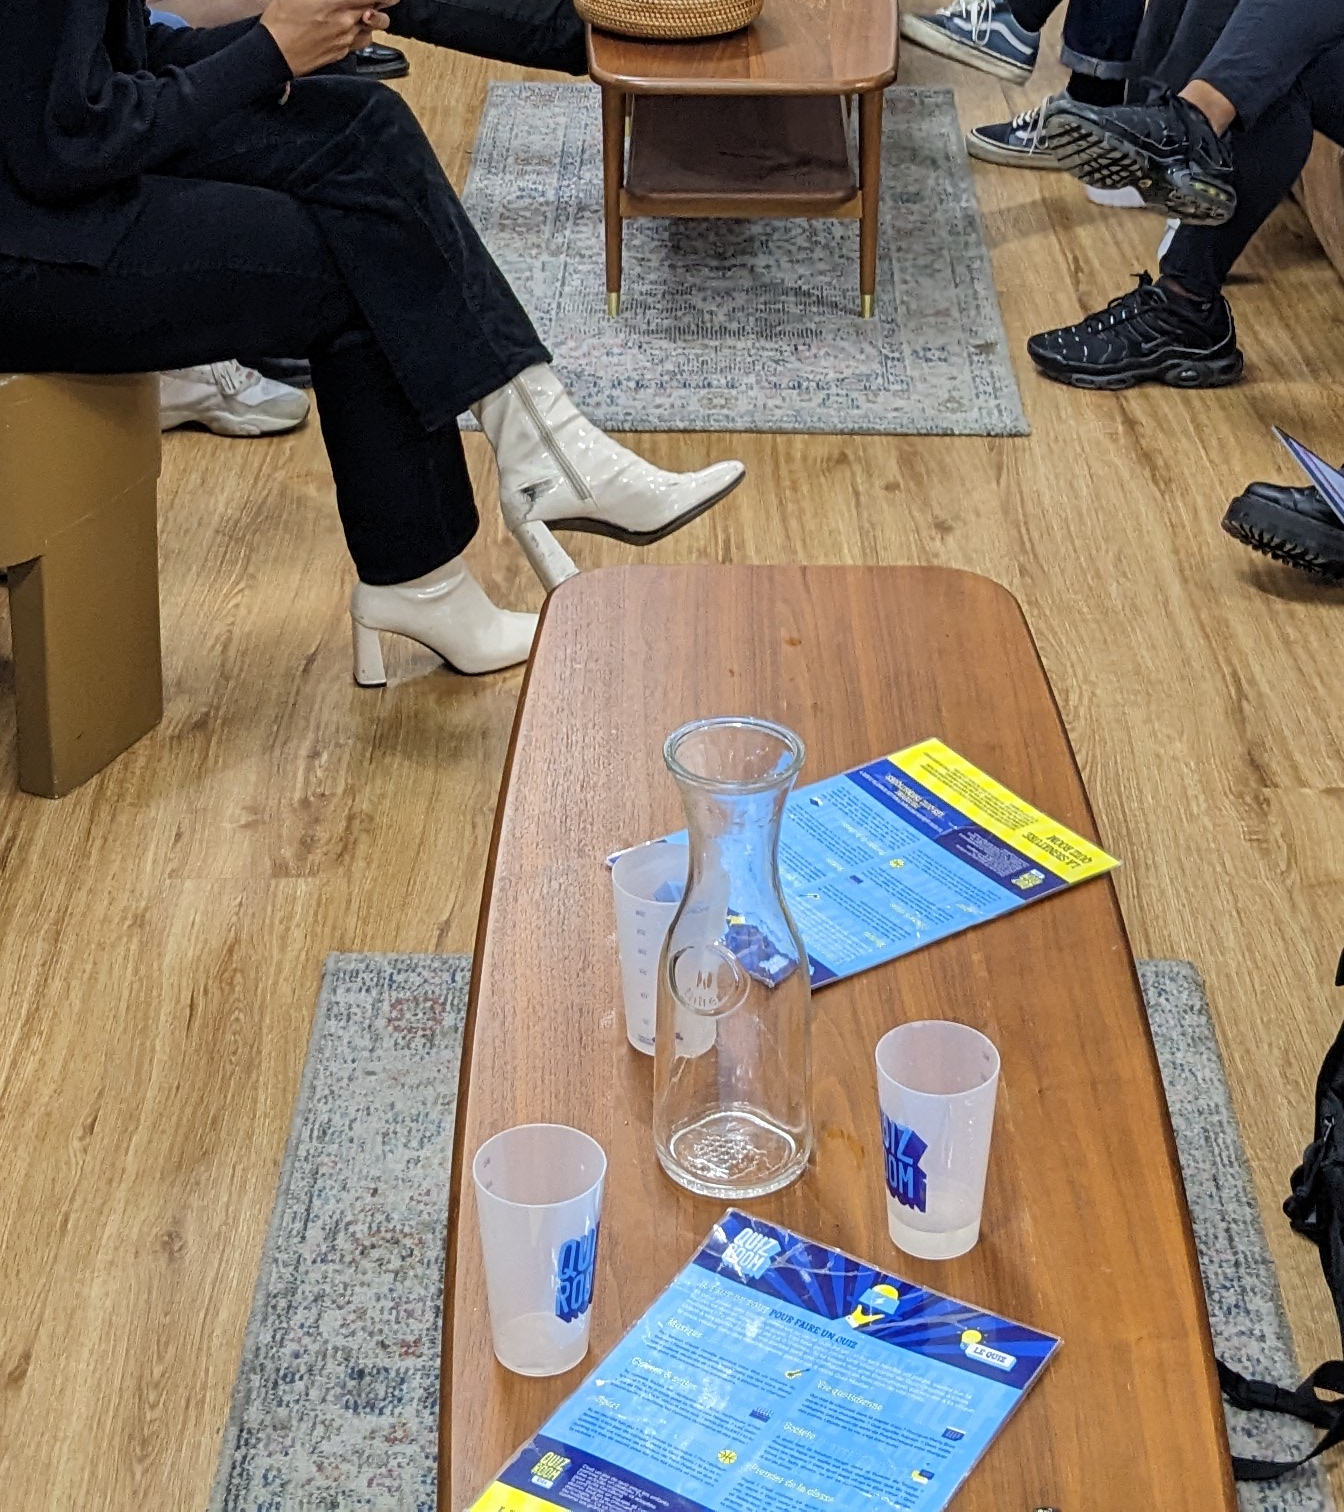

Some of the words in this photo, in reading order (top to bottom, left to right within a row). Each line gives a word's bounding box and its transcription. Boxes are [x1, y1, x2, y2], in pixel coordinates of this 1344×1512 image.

[885, 1151, 914, 1198] OM
[734, 1228, 778, 1255] QUIZ
[724, 1245, 766, 1272] ROOM
[768, 1308, 795, 1323] POUR
[792, 1318, 822, 1334] FAIRE
[819, 1329, 836, 1340] UN
[834, 1334, 859, 1349] QUIZ
[973, 1346, 986, 1357] LE
[985, 1350, 1008, 1364] QUIZ
